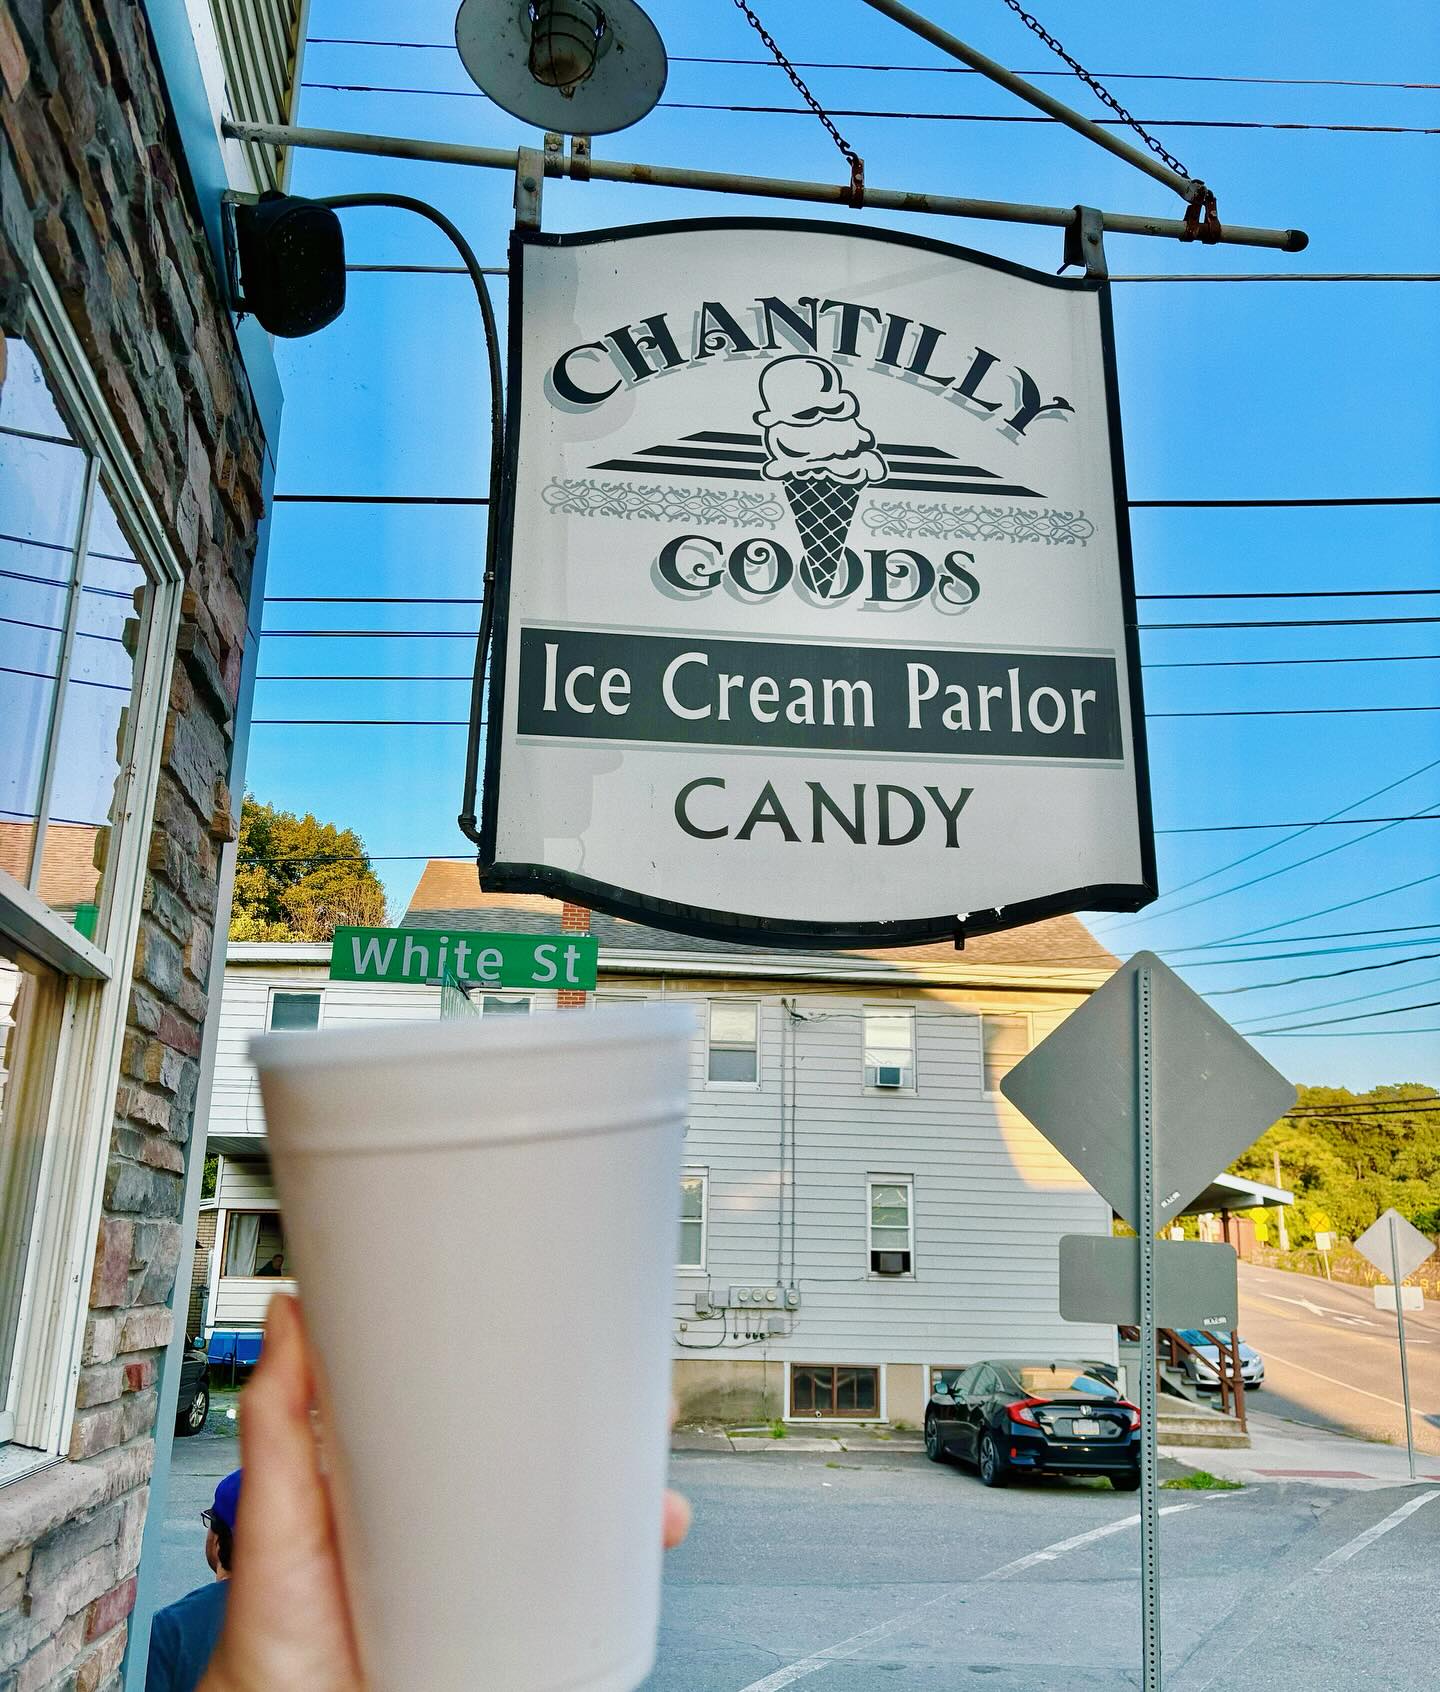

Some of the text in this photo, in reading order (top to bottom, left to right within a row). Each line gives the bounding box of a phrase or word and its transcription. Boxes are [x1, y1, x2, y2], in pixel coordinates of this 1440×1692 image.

[551, 296, 1077, 439] CHANTILLY
[657, 533, 982, 605] GOODS
[541, 642, 1098, 737] Ice Cream Parlor
[673, 776, 976, 850] CANDY
[350, 935, 582, 984] White St
